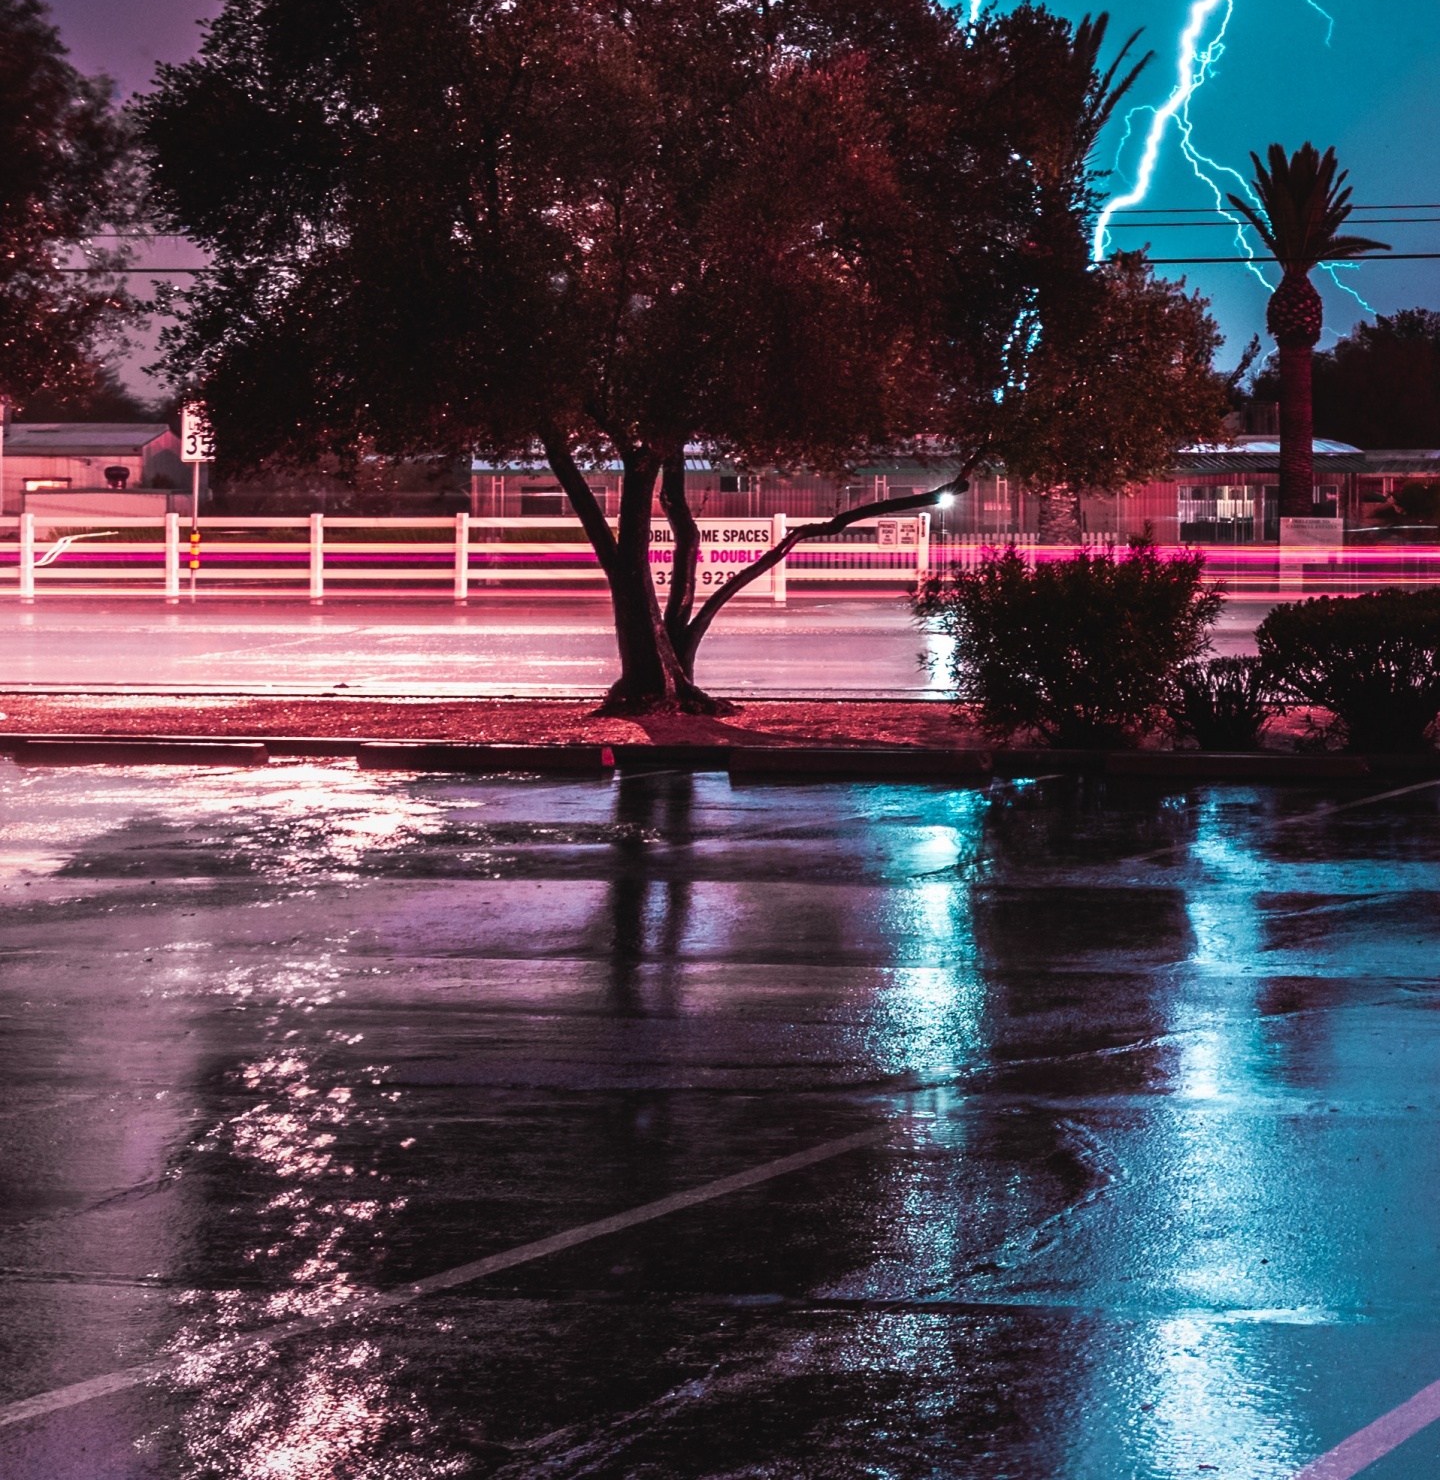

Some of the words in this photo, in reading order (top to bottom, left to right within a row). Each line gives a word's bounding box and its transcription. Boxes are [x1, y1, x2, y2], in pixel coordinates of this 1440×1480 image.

[186, 435, 211, 456] 35
[648, 529, 674, 542] OBIL
[701, 529, 719, 542] ME
[722, 529, 769, 542] SPACES
[648, 550, 672, 563] ING
[710, 550, 763, 563] DOUBLE
[702, 571, 736, 585] 928
